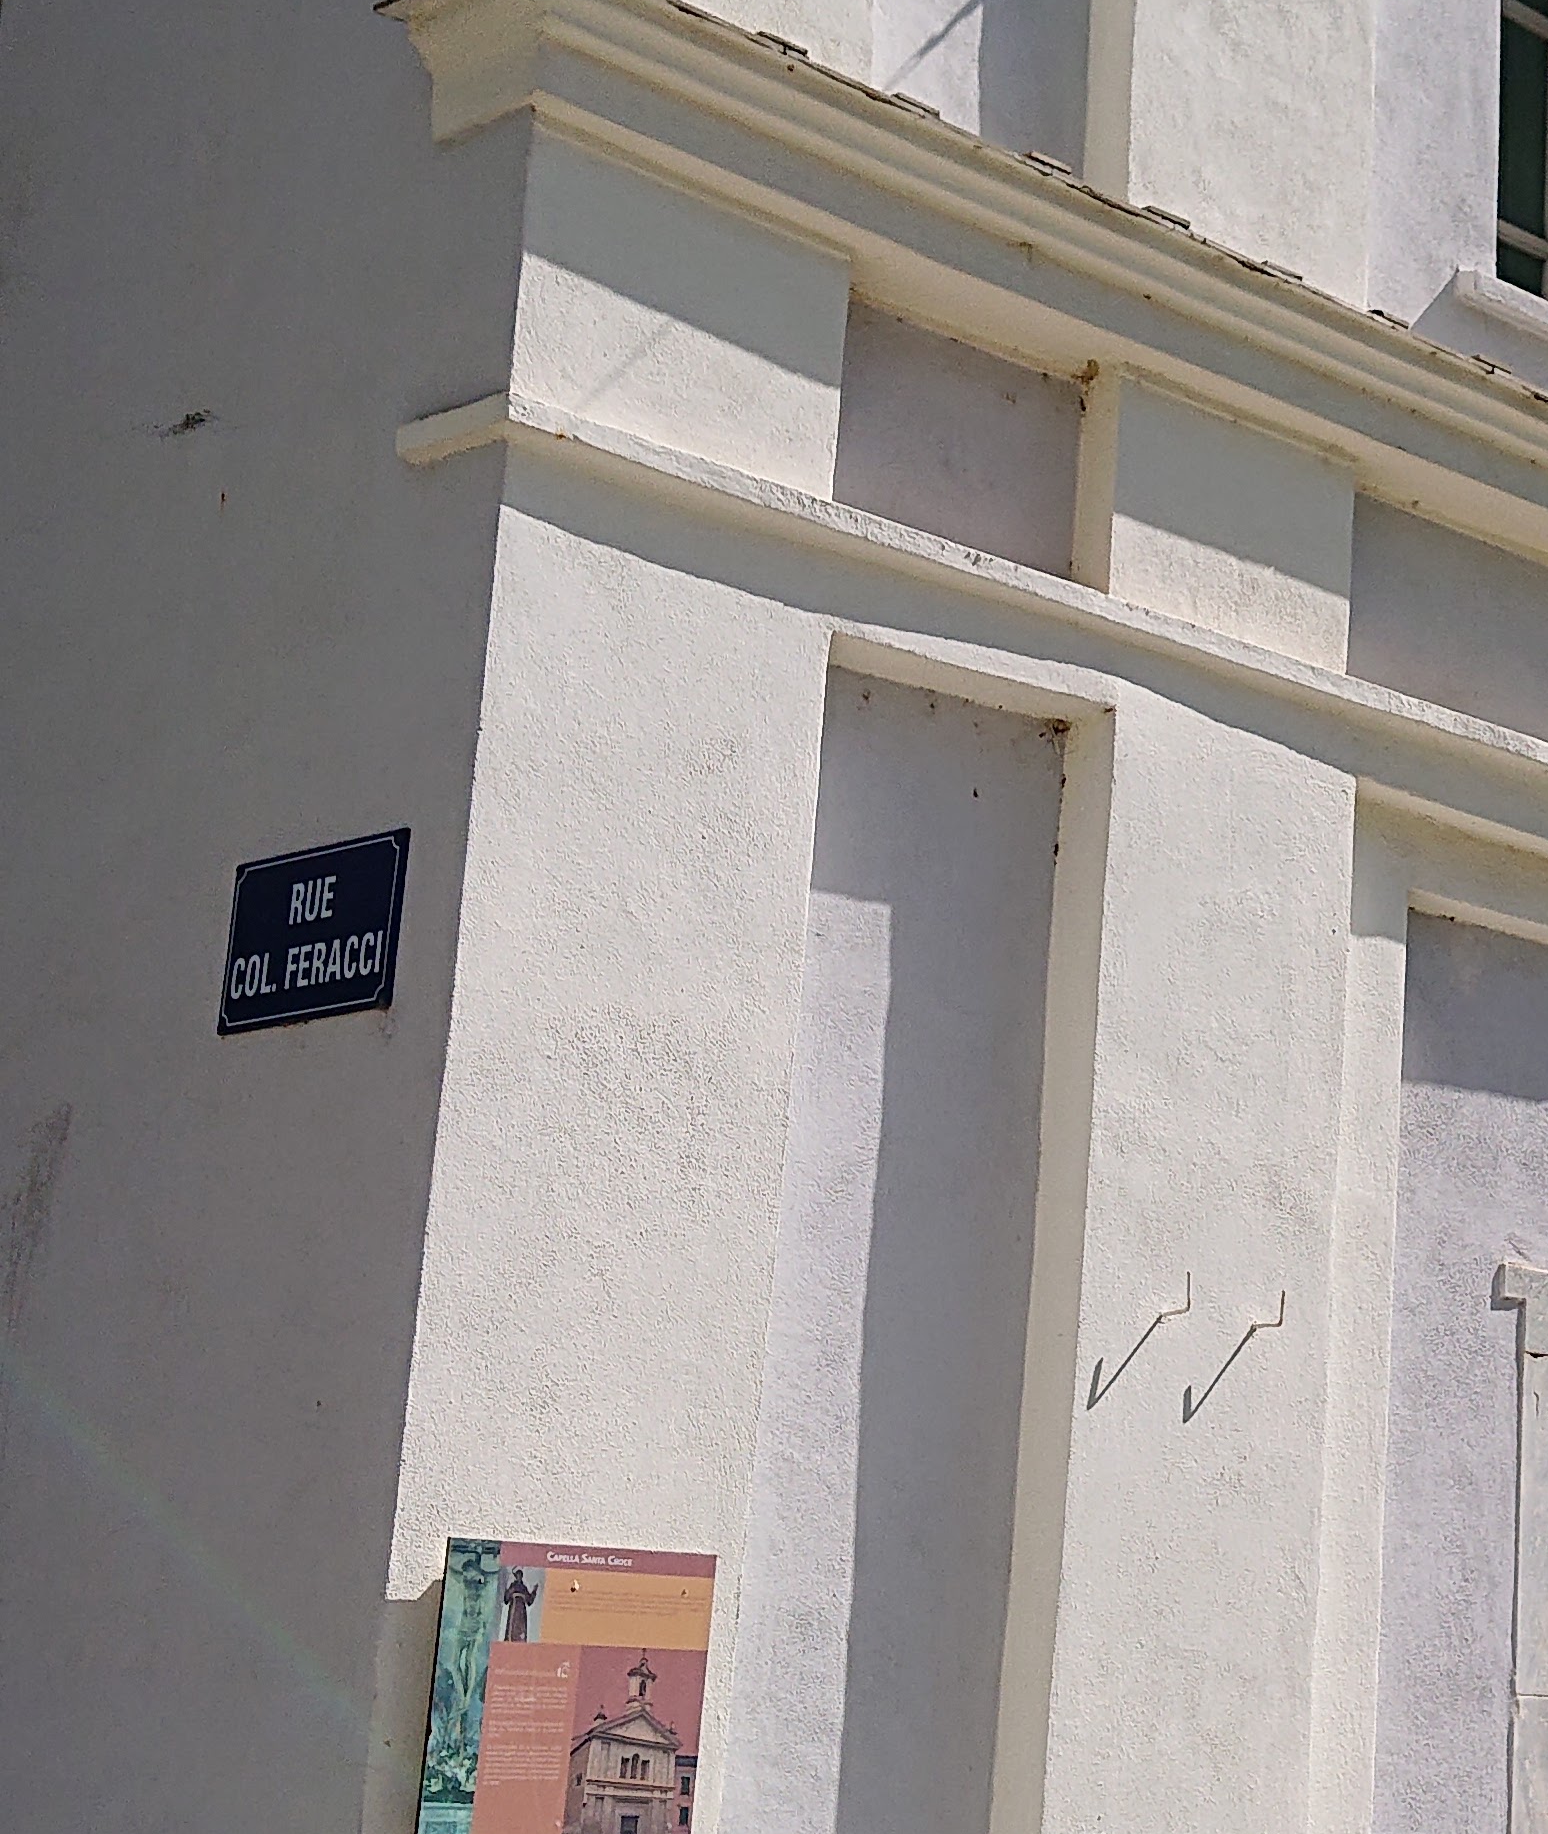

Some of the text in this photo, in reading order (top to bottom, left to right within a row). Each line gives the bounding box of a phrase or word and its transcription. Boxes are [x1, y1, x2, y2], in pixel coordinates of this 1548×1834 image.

[289, 875, 337, 925] RUE
[230, 930, 384, 1000] COL. FERACCI
